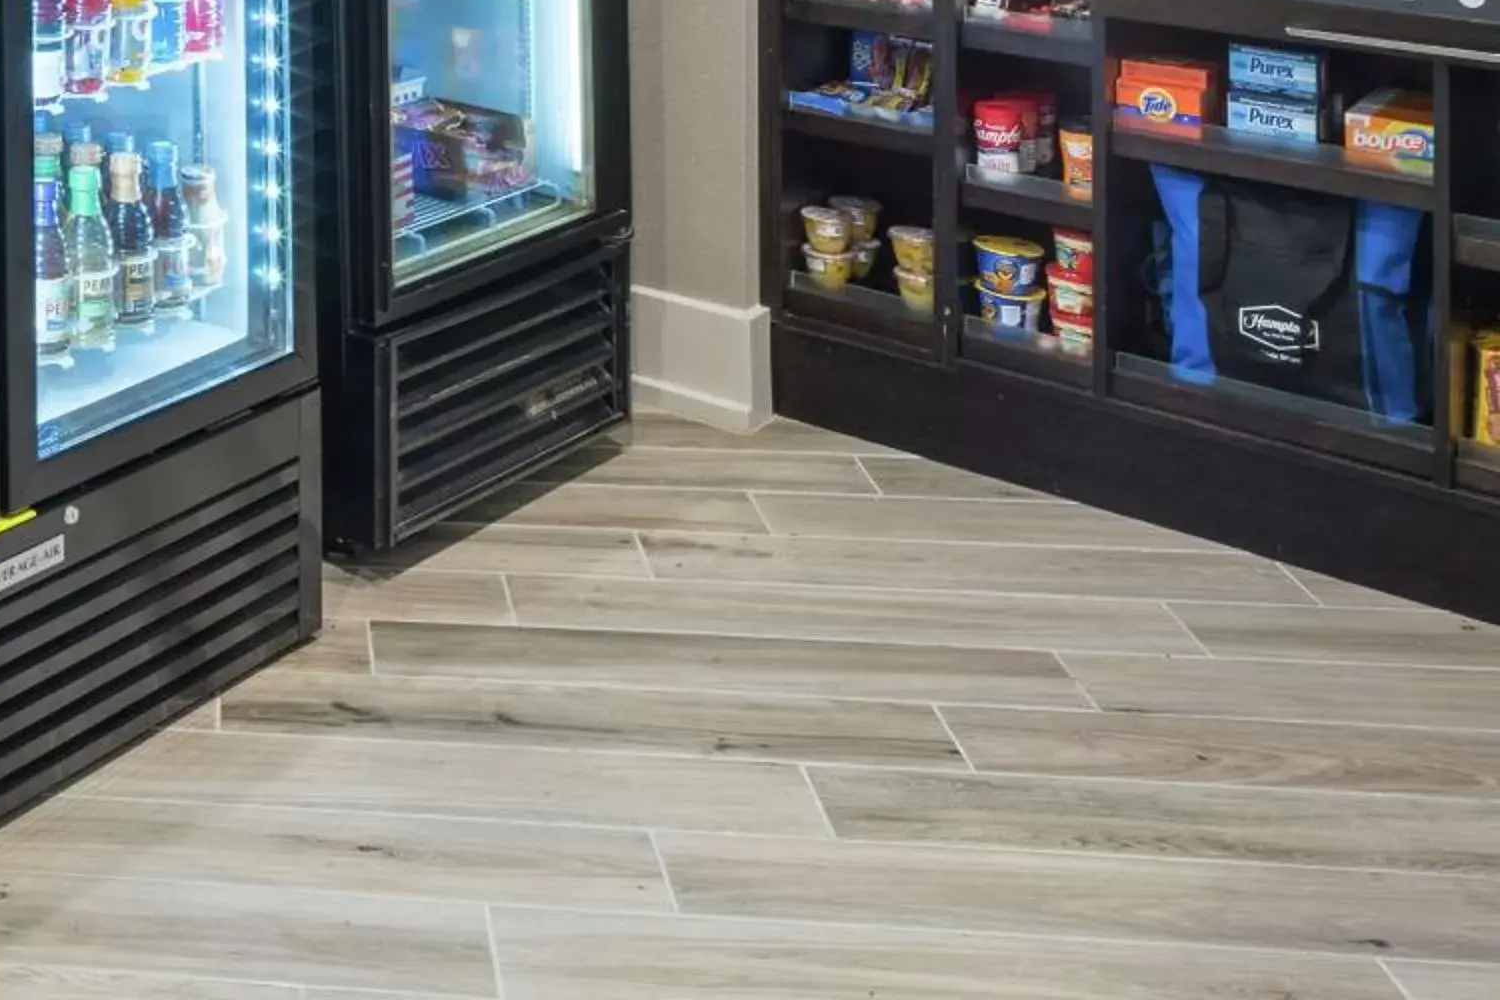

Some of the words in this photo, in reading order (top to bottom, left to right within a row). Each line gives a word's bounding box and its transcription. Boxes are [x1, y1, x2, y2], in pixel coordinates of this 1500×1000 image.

[1251, 56, 1294, 79] Purex
[1143, 96, 1173, 113] Tide
[1250, 107, 1293, 130] Purex
[1354, 129, 1426, 152] bounce
[1243, 313, 1301, 334] Hampto
